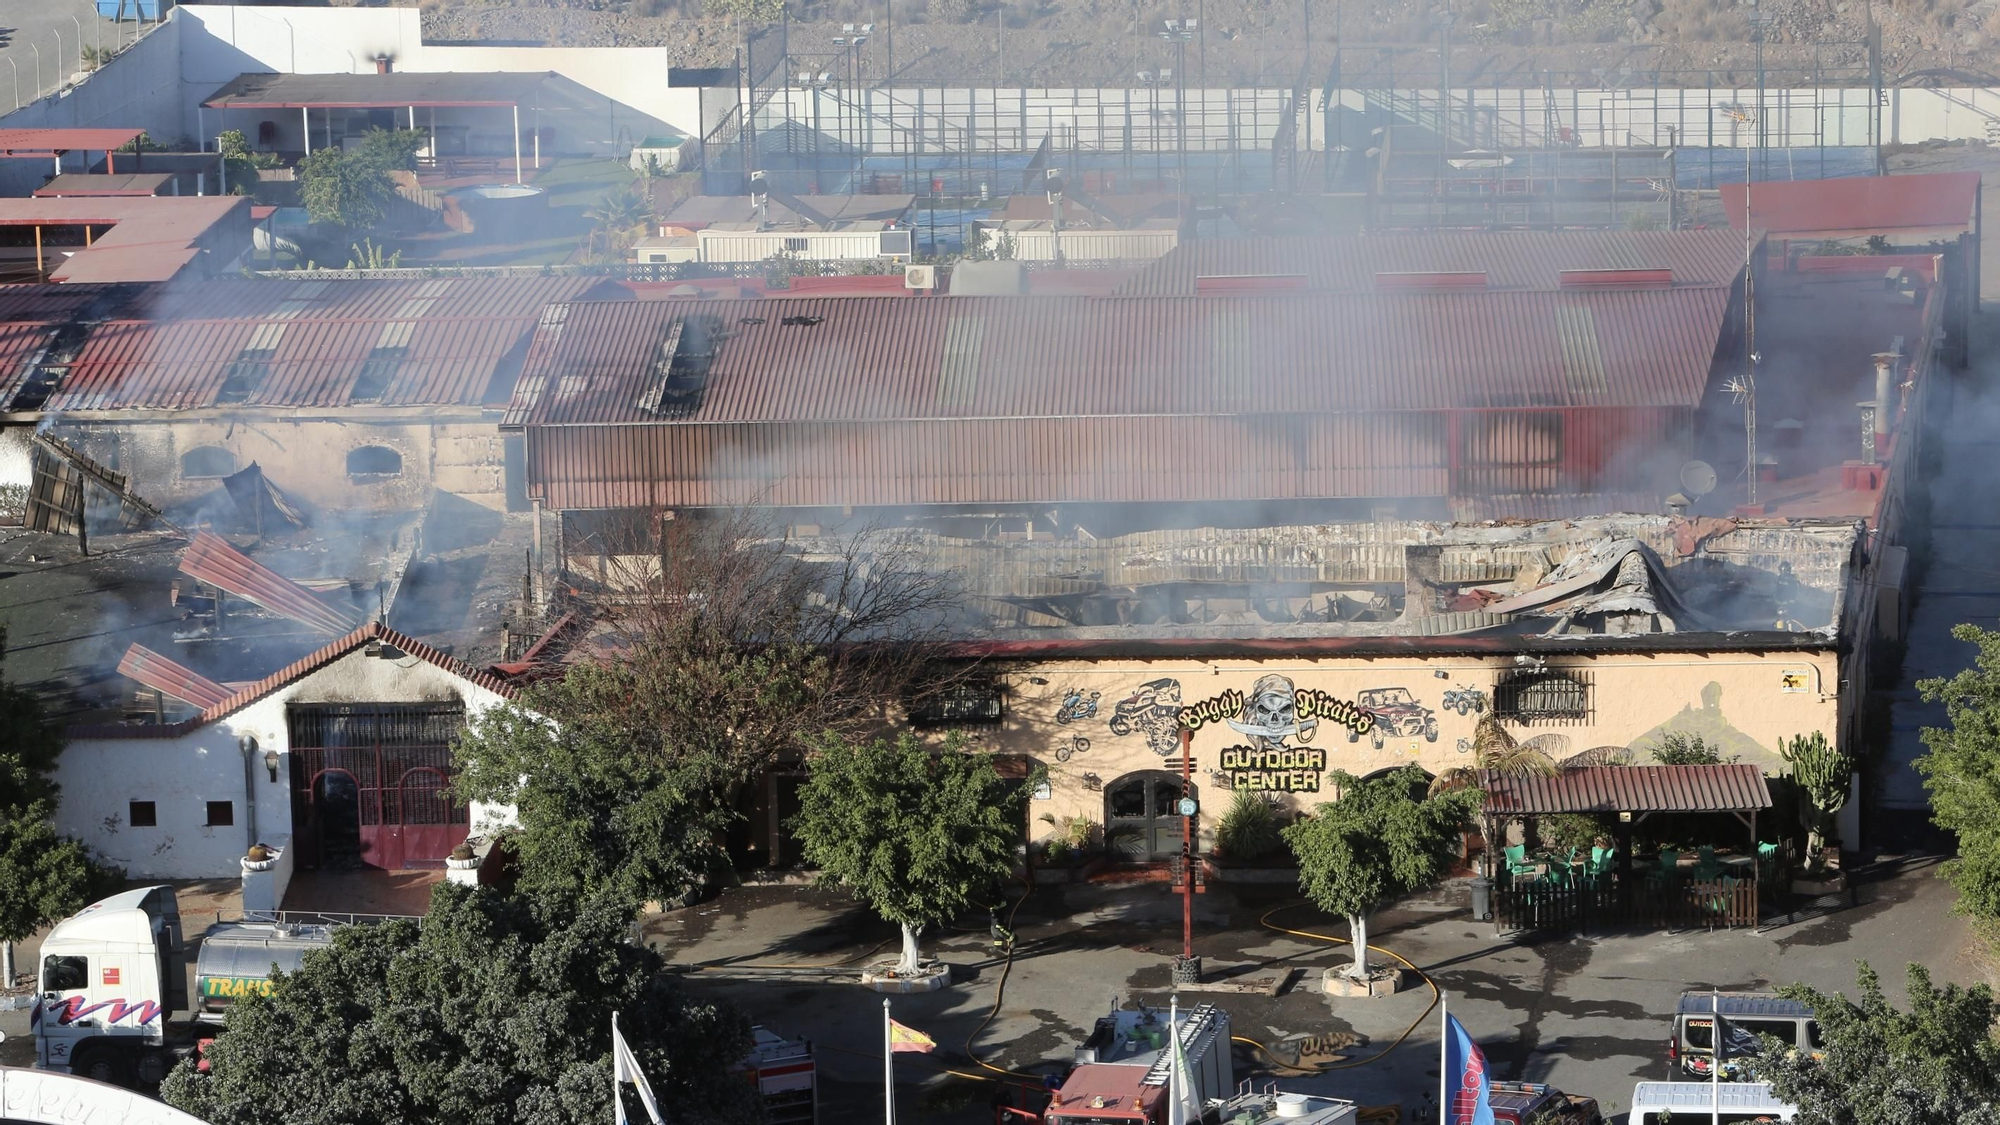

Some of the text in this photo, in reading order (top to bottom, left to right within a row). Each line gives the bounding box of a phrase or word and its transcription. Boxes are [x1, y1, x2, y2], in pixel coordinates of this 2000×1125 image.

[1178, 689, 1375, 734] Buggy Pirates
[1222, 747, 1324, 770] OUTDOOR
[1233, 768, 1319, 791] CENTER
